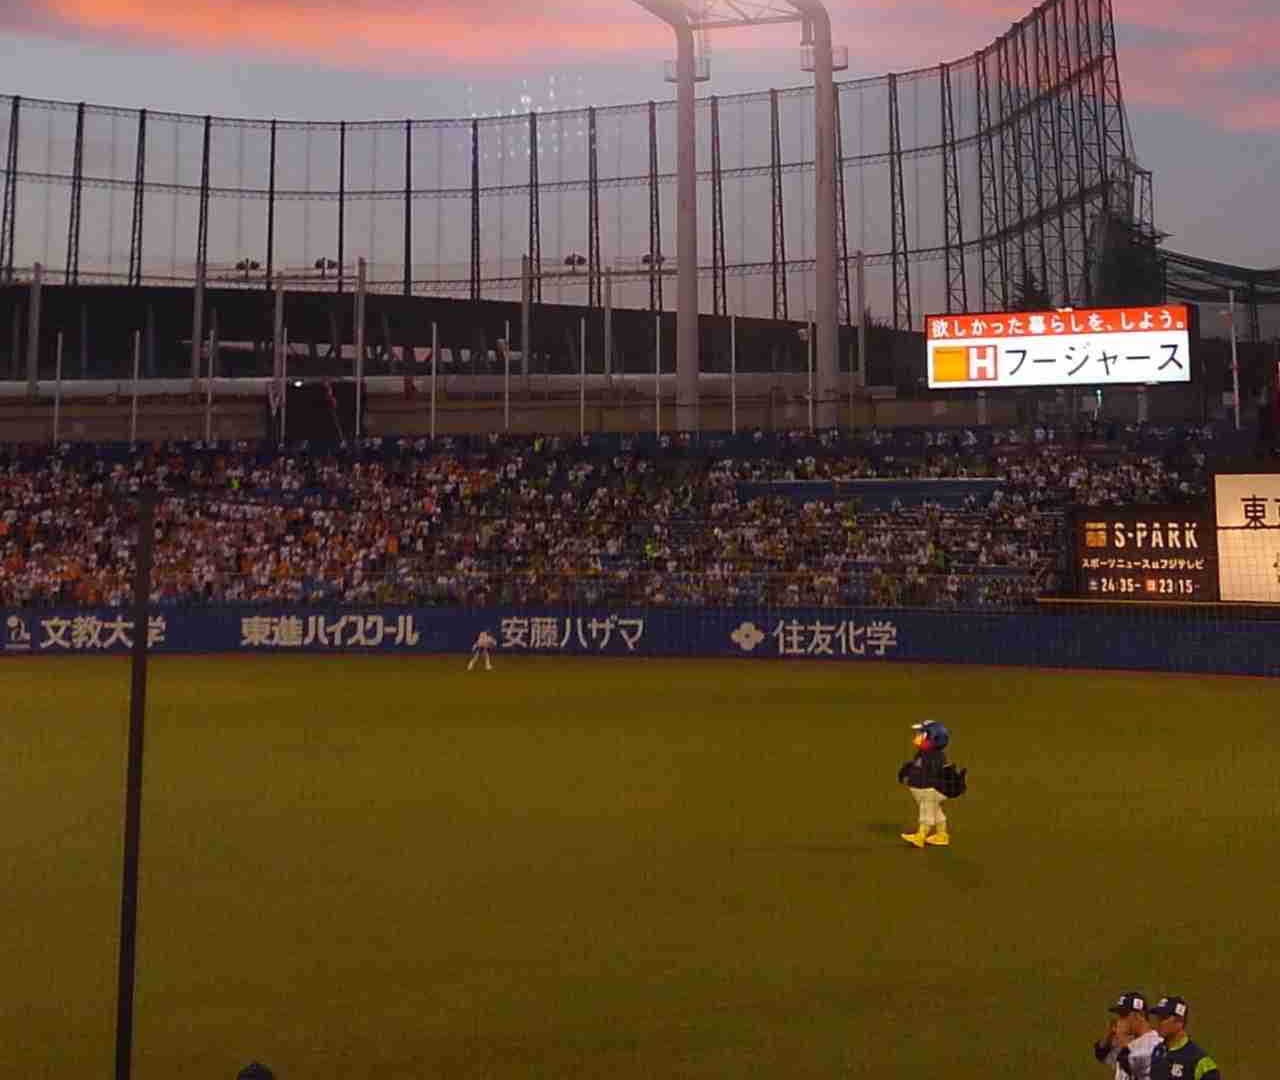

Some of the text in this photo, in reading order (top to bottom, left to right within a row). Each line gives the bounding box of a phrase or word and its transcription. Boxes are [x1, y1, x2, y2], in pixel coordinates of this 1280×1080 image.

[1005, 342, 1184, 376] フージャース
[239, 614, 420, 647] 東進ハイスクール
[500, 614, 645, 650] 安藤ハザマ
[772, 618, 898, 656] 住友化学
